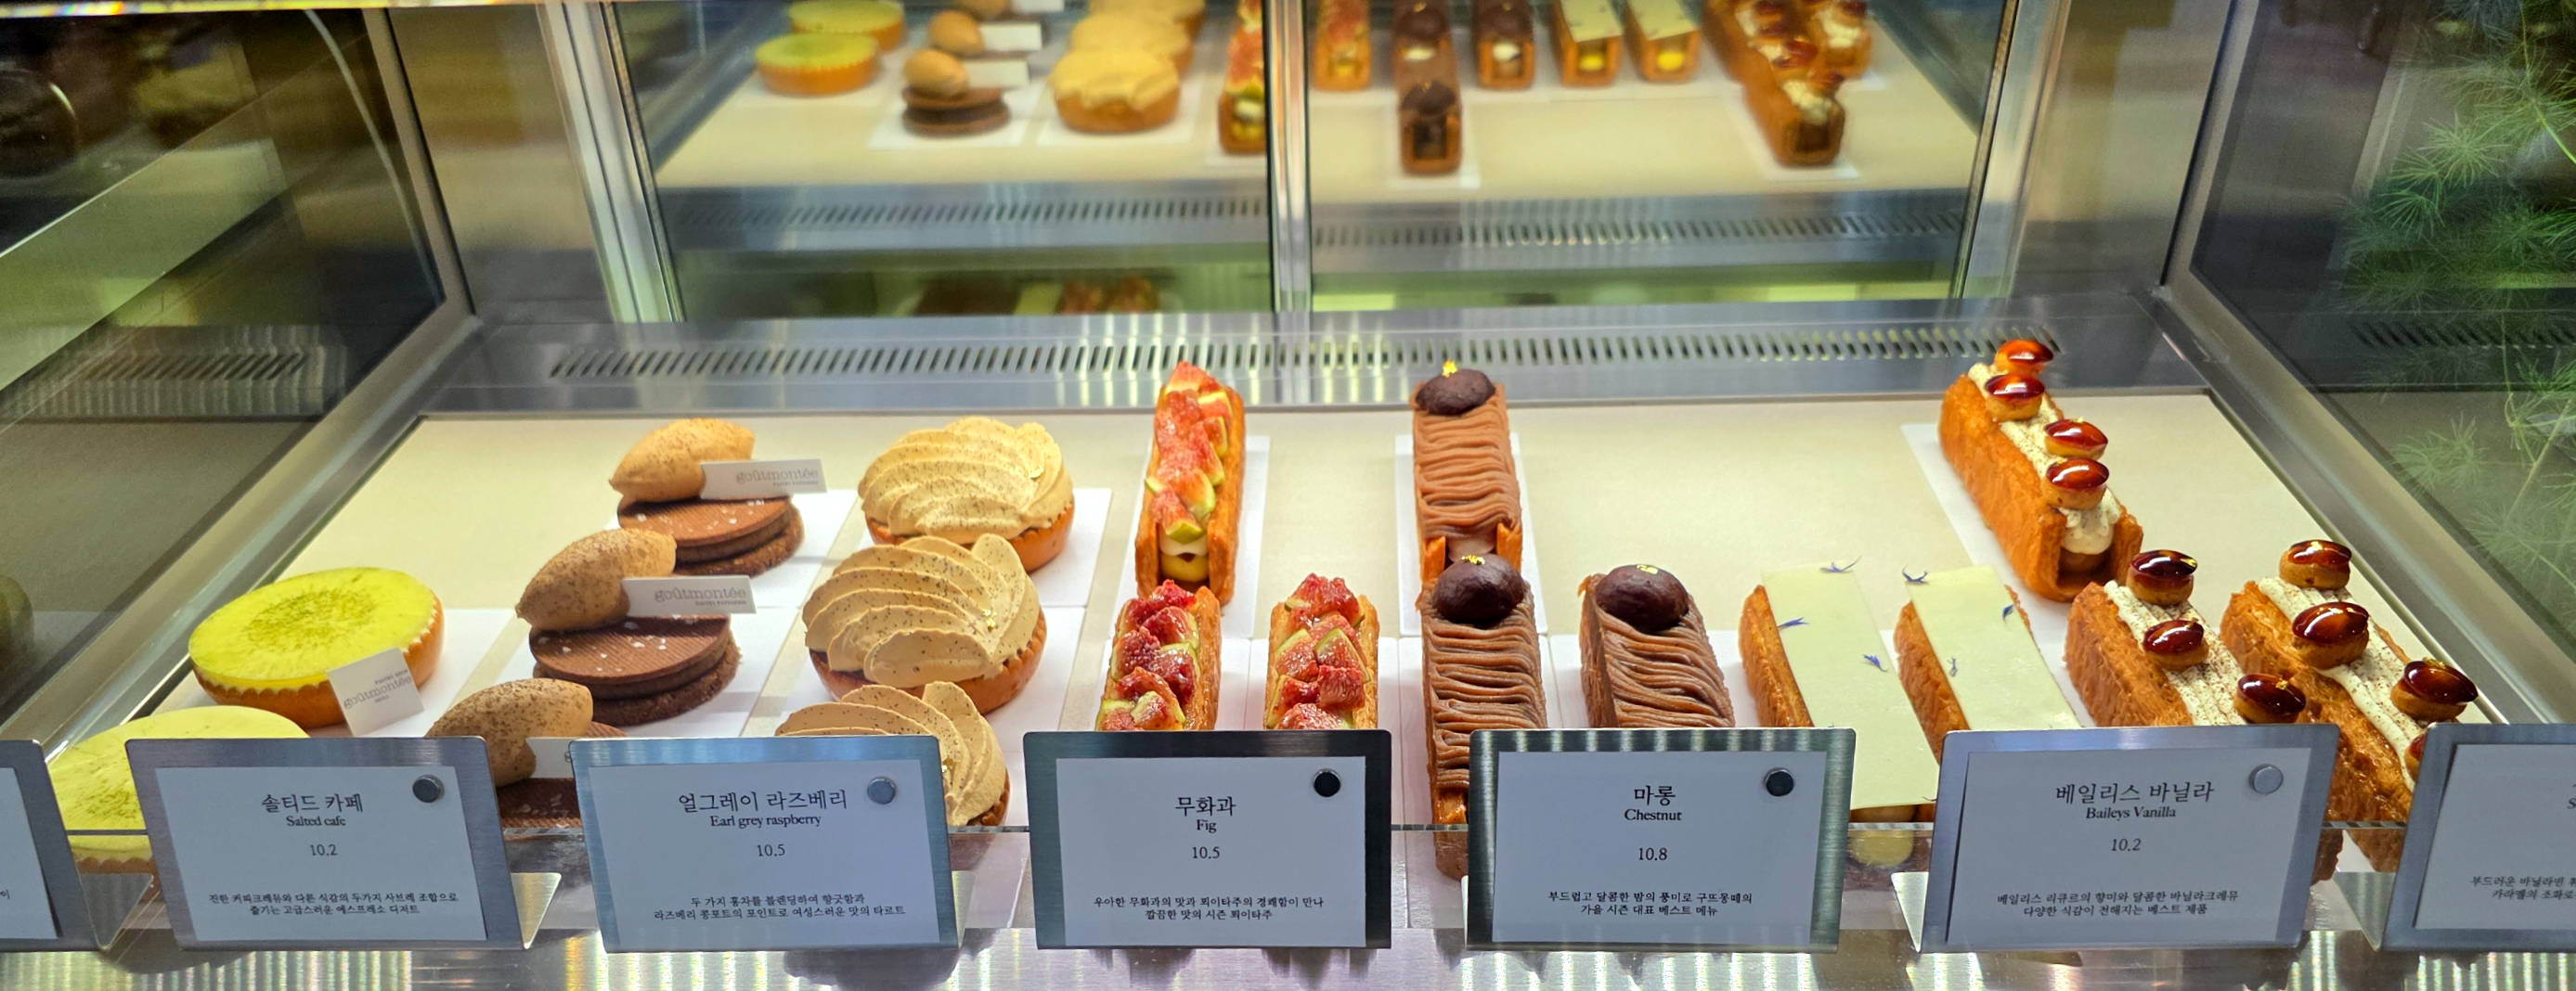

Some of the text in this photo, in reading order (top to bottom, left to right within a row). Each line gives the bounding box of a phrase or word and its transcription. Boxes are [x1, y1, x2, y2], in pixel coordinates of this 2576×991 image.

[654, 586, 746, 603] goûtmontée
[343, 676, 412, 710] goûtmontée
[1634, 785, 1676, 806] 마롱
[2056, 781, 2215, 804] 베일리스 바닐라
[262, 793, 363, 813] 솔티드 카페
[679, 790, 847, 813] 얼그레이 라즈베리
[1175, 796, 1236, 817] 무화과
[2567, 798, 2576, 810] S
[1624, 808, 1682, 821] Chestnut
[2086, 806, 2176, 821] Baileys Vanilla
[286, 816, 346, 827] Salted cafe
[709, 814, 822, 829] Earl grey raspberry
[1197, 819, 1217, 833] Fig
[310, 843, 339, 856] 10.2
[757, 843, 785, 857] 10.5
[2111, 838, 2142, 852] 10.2
[1192, 846, 1221, 859] 10.5
[1638, 847, 1667, 861] 10.8
[2470, 876, 2516, 887] 부드러운
[2518, 876, 2564, 888] 바닐라빈
[295, 893, 317, 904] 다른
[318, 893, 349, 904] 식감의
[352, 893, 382, 903] 두가지
[385, 893, 415, 903] 사브레
[419, 893, 459, 903] 조합으로
[691, 897, 702, 907] 두
[705, 896, 726, 907] 가지
[822, 894, 865, 905] 향긋함과
[1094, 896, 1126, 907] 우아한
[1129, 896, 1171, 907] 무화과의
[1174, 896, 1197, 907] 맛과
[1257, 896, 1299, 907] 경쾌함이
[1302, 896, 1325, 907] 만나
[1547, 891, 1753, 905] 부드럽고 달콤한 밤의 풍미로 구뜨몽떼의
[1997, 890, 2238, 905] 베일리스 리큐르의 향미와 달콤한 바닐라크레뮤
[2540, 889, 2576, 900] 조화로
[283, 905, 333, 915] 고급스러운
[389, 904, 420, 915] 디저트
[654, 905, 906, 920] 라즈베리 콩포트의 포인트로 여성스러운 맛의 타르트
[1146, 908, 1176, 920] 깔끔한
[1181, 908, 1201, 920] 맛의
[1205, 908, 1227, 920] 시즌
[1581, 904, 1718, 917] 가을 시즌 대표 베스트 메뉴
[2024, 903, 2207, 917] 다양한 식감이 전해지는 베스트 제품
